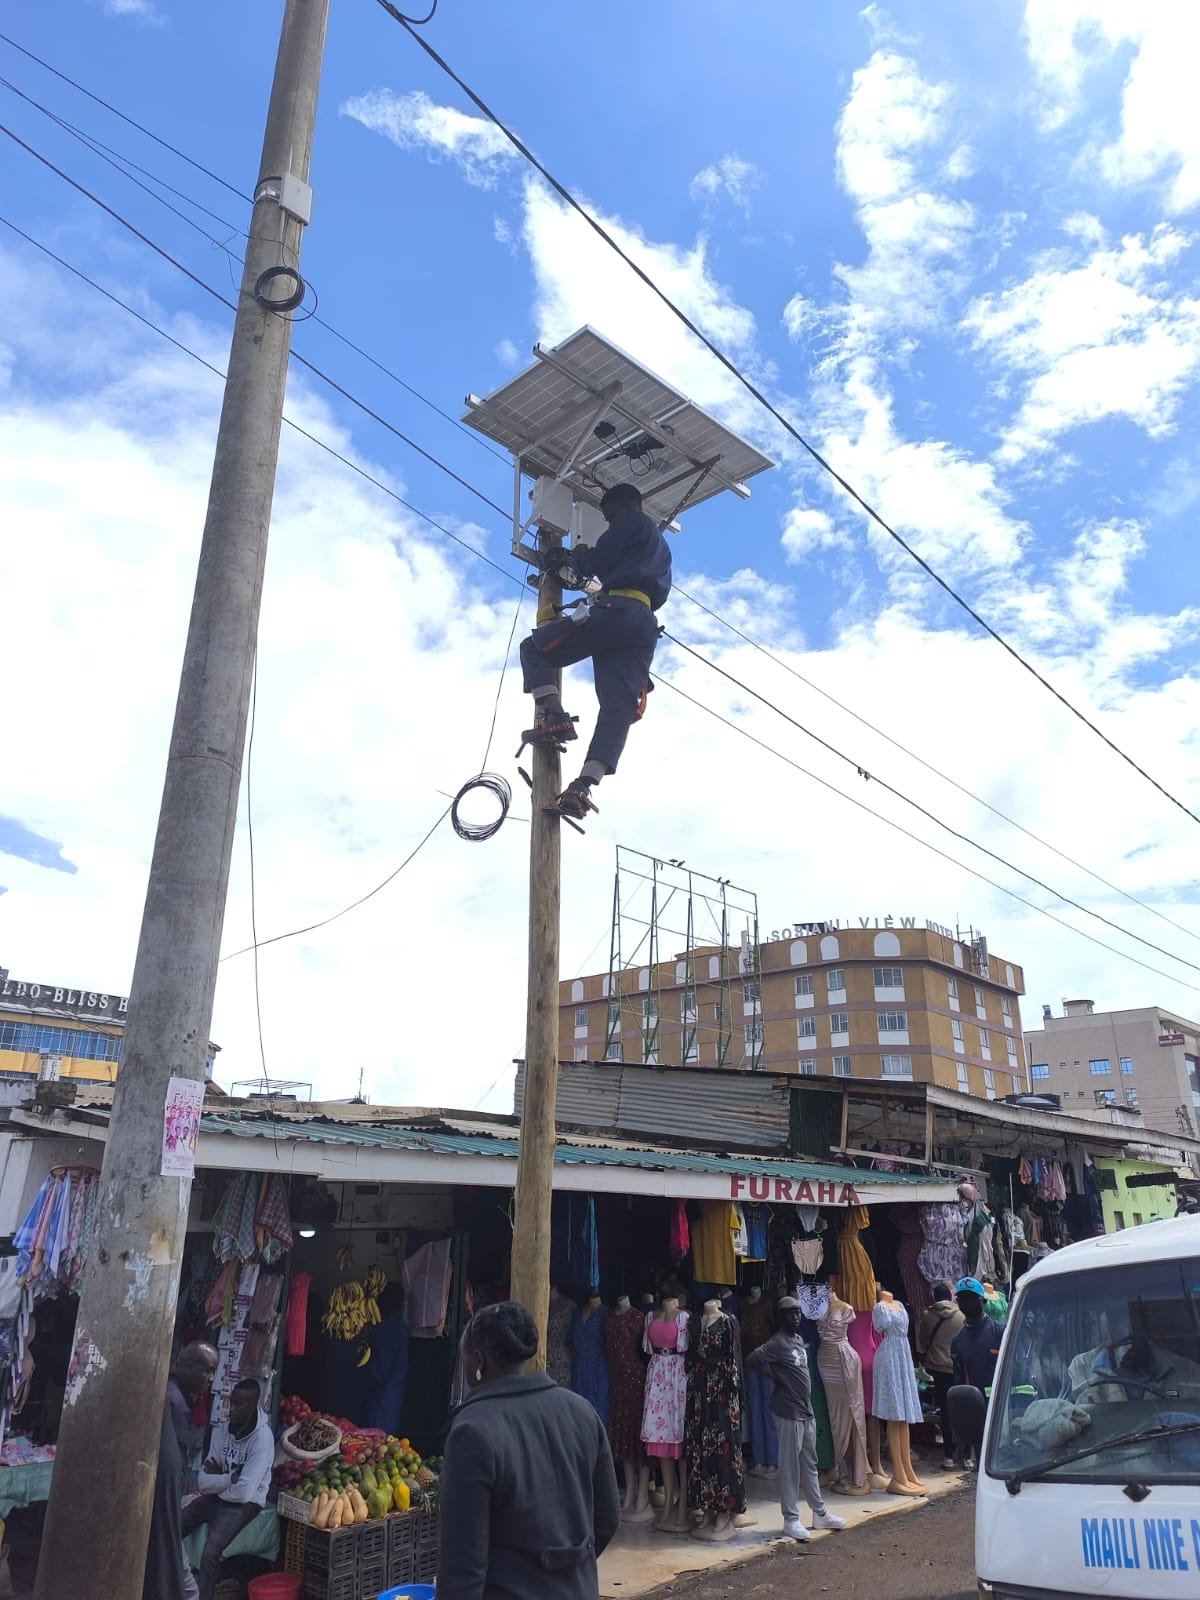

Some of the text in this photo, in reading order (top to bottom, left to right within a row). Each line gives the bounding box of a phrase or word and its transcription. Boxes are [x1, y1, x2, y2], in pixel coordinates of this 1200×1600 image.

[859, 916, 916, 929] VIEW
[925, 919, 954, 939] HOTEL
[119, 997, 129, 1012] H
[731, 1174, 860, 1205] FURAHA
[1081, 1518, 1140, 1569] MAILI
[1143, 1518, 1188, 1571] NNE
